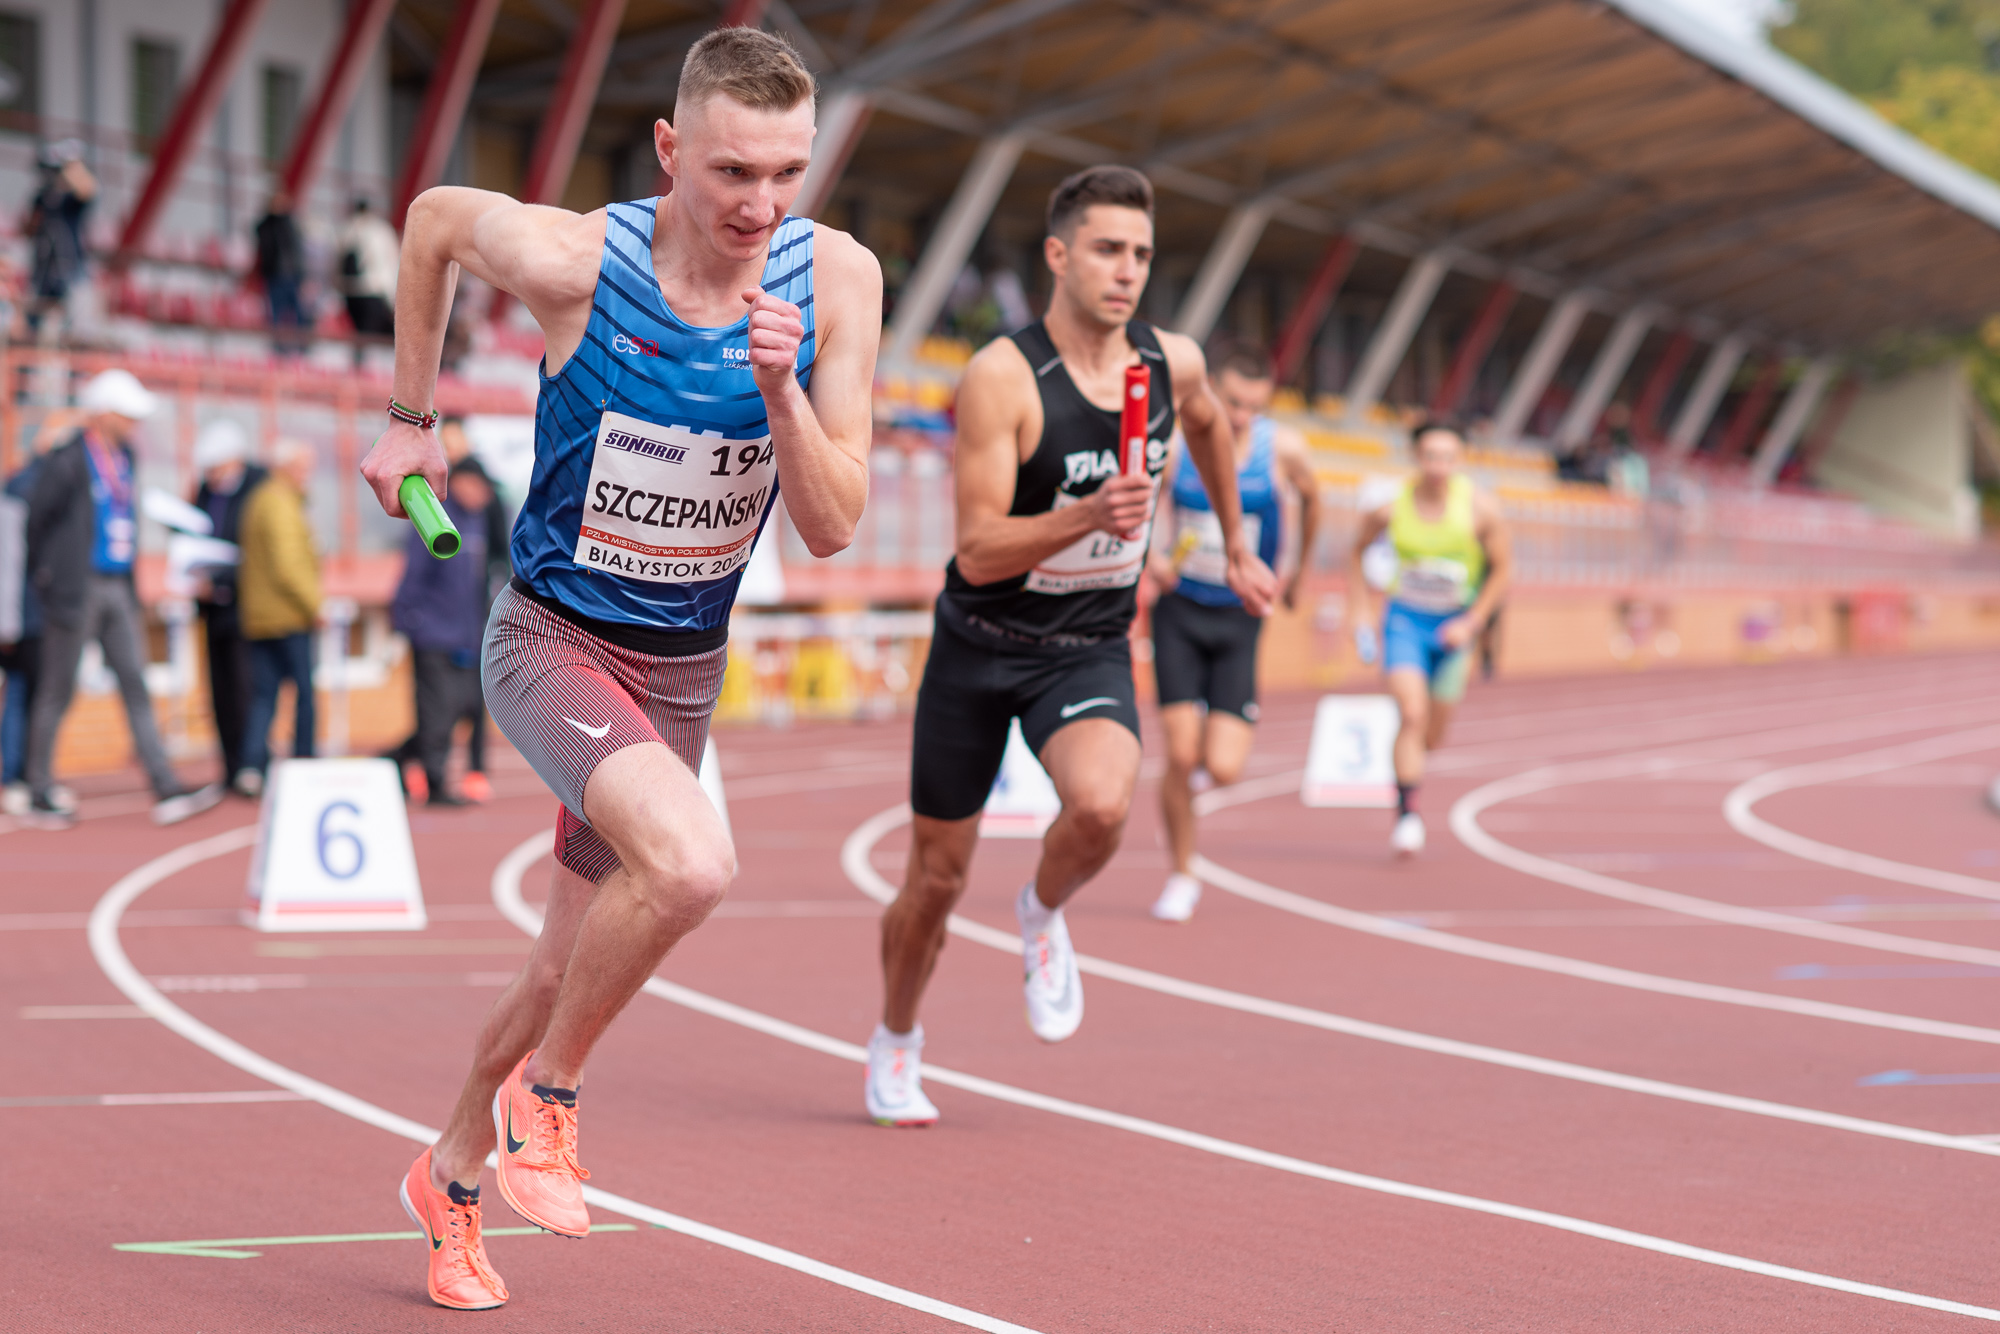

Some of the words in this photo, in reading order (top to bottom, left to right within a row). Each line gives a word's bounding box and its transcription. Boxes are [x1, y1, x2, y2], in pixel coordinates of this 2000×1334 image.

[722, 347, 750, 361] KO
[603, 430, 688, 464] SONAROL
[709, 439, 775, 476] 194
[591, 480, 768, 529] SZCZEPAŃSKI
[586, 529, 610, 542] PZLA
[610, 536, 675, 556] MISTRZOSTWA
[676, 548, 708, 556] POLSKI
[588, 545, 706, 577] BIAŁYSTOK
[709, 546, 747, 575] 2022
[1340, 721, 1372, 777] 3
[317, 800, 365, 879] 6
